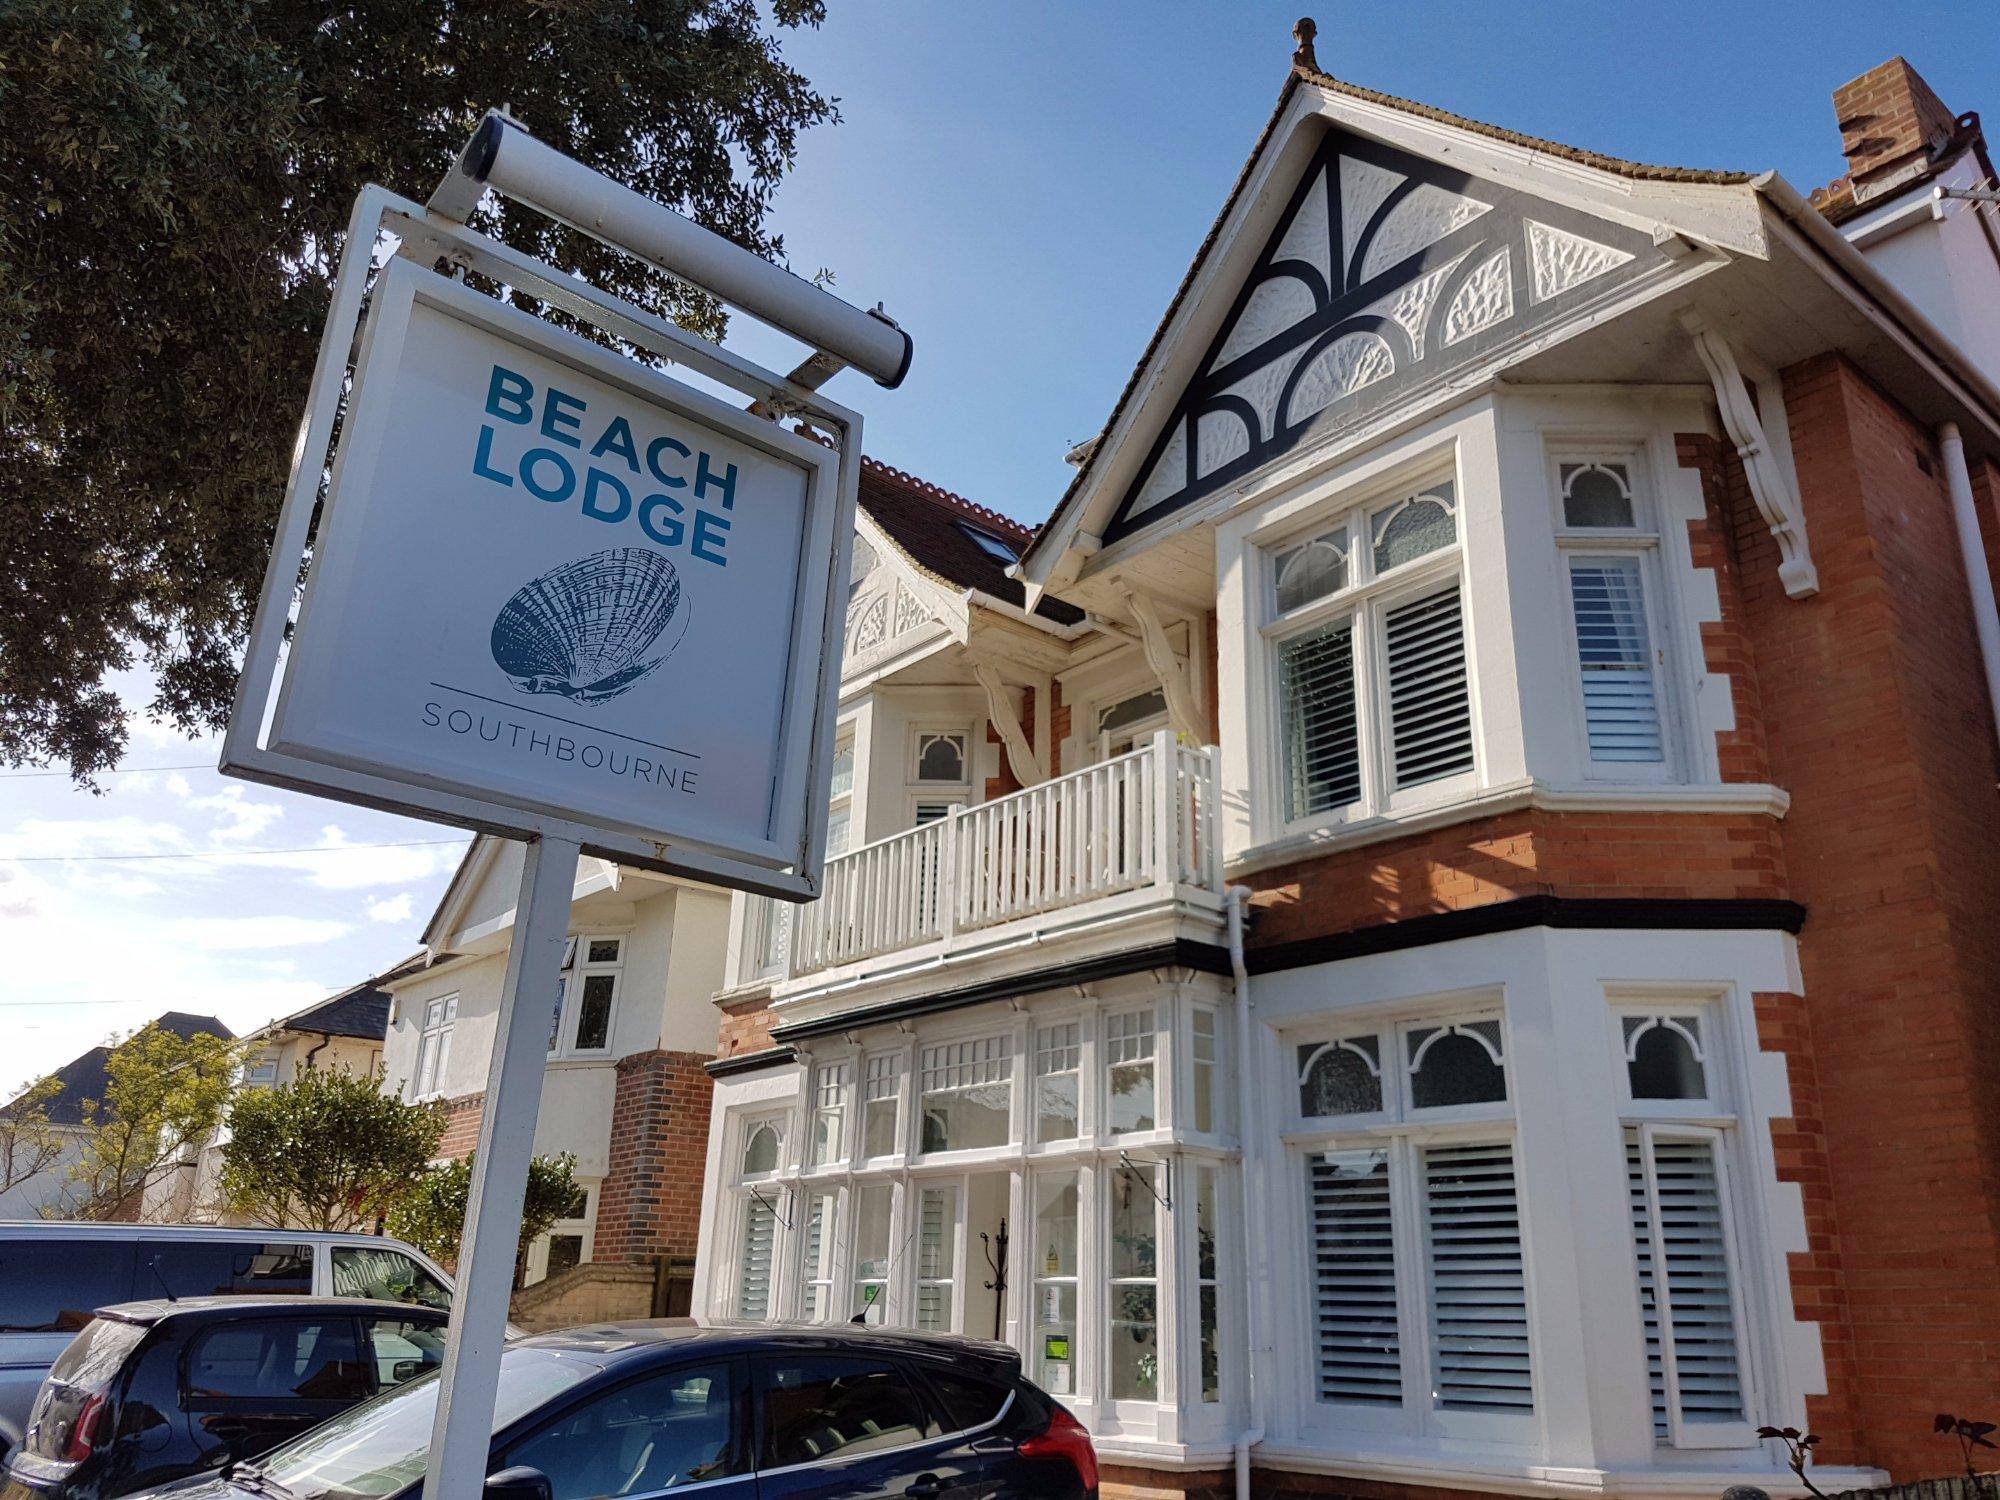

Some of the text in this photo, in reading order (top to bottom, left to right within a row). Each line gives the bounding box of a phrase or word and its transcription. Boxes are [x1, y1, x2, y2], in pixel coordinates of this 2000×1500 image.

[473, 424, 732, 567] LODGE
[485, 365, 737, 511] BEACH
[421, 702, 700, 795] SOUTHBOURNE
